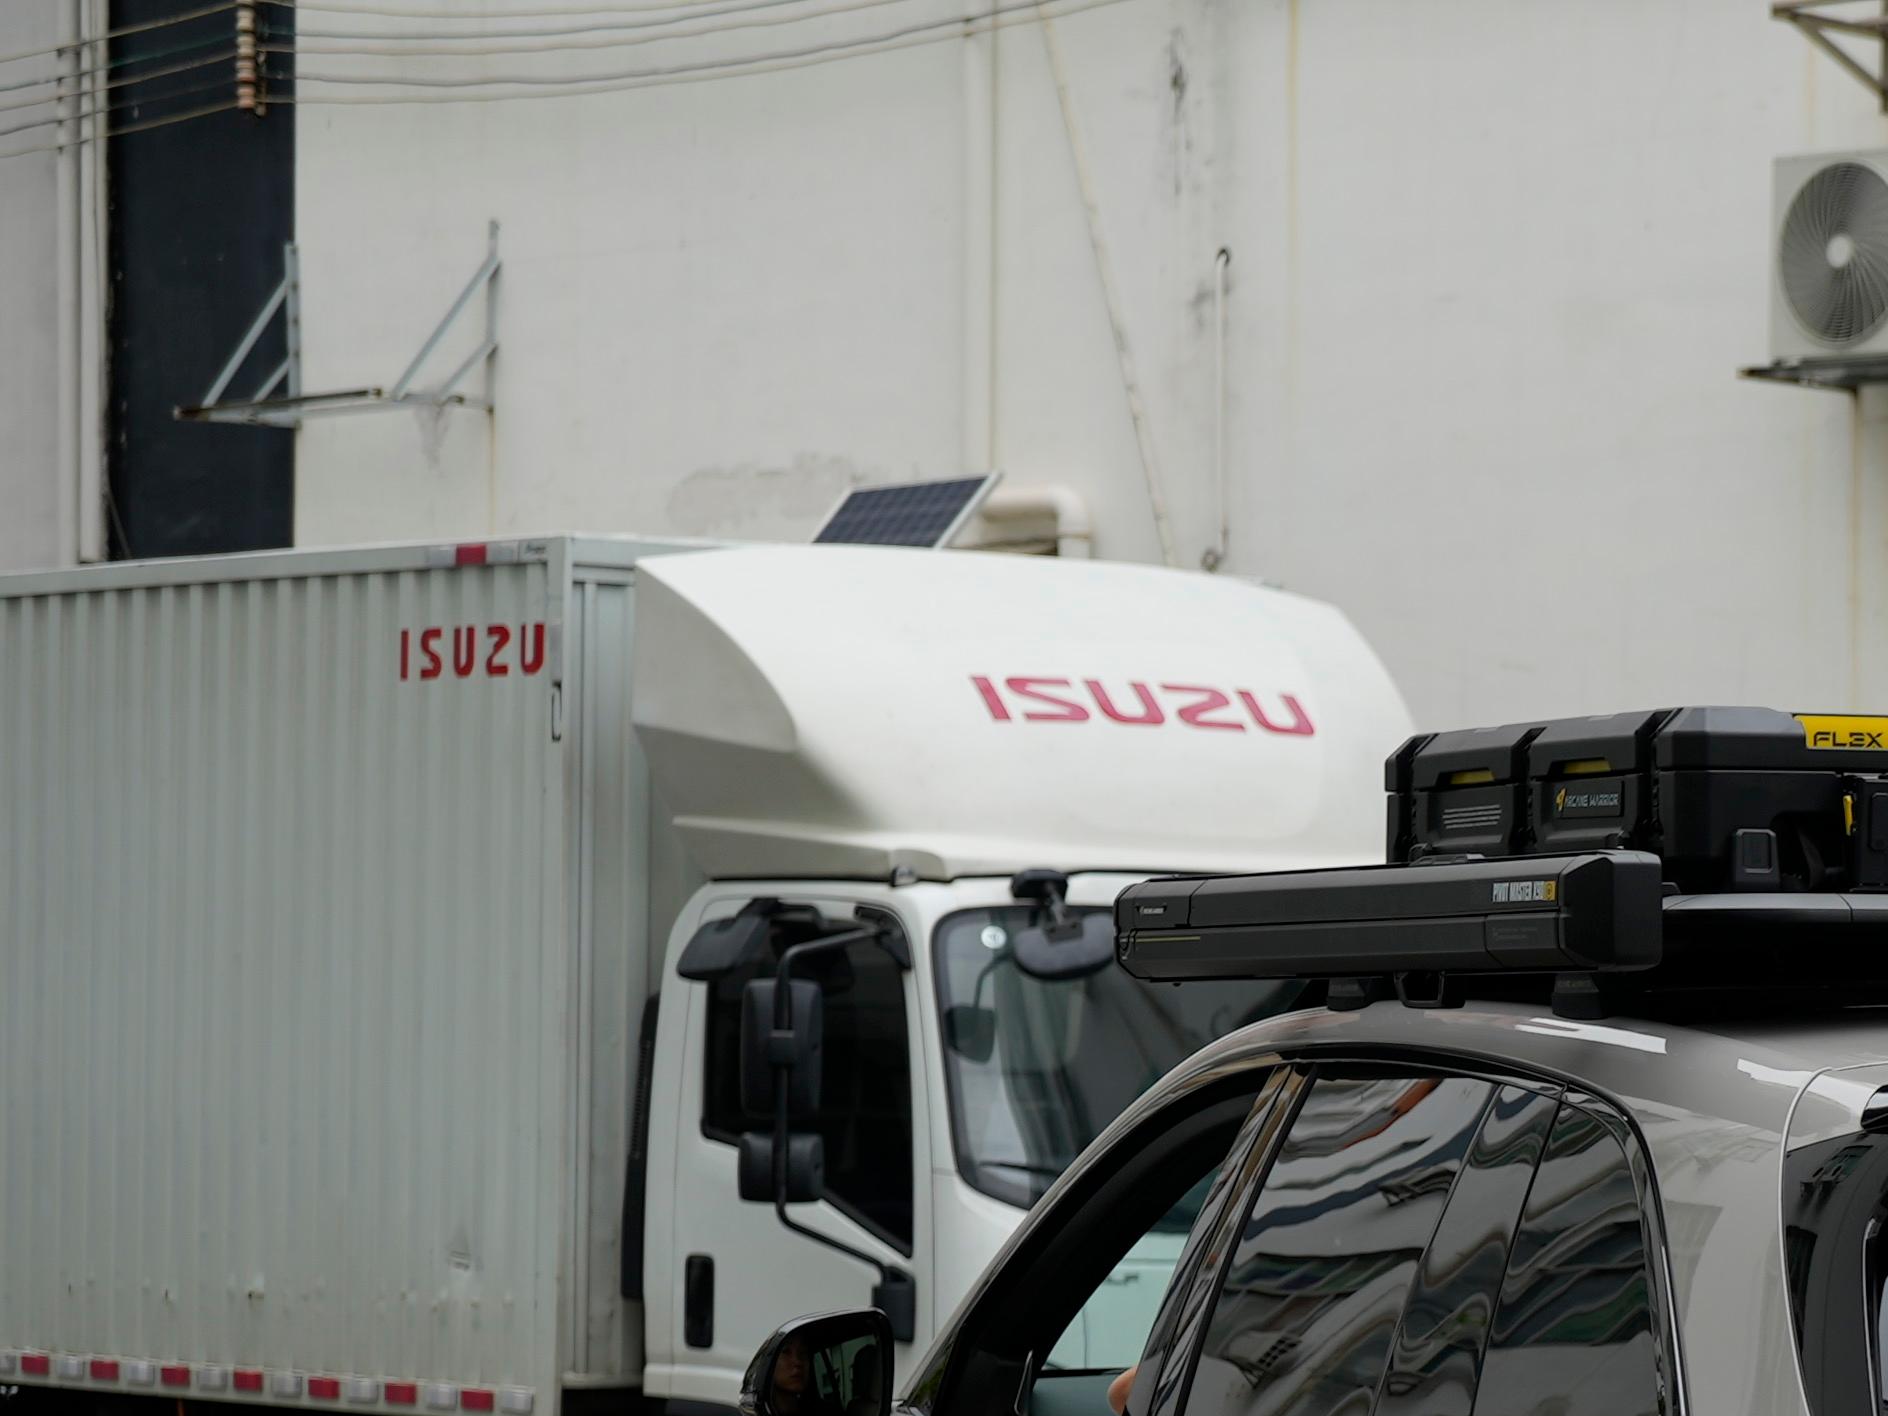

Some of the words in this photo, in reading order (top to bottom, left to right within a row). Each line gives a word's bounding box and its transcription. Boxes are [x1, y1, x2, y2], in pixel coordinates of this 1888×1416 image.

[400, 622, 546, 682] ISUZU
[970, 676, 1315, 737] ISUZU
[1813, 731, 1883, 748] FLEX
